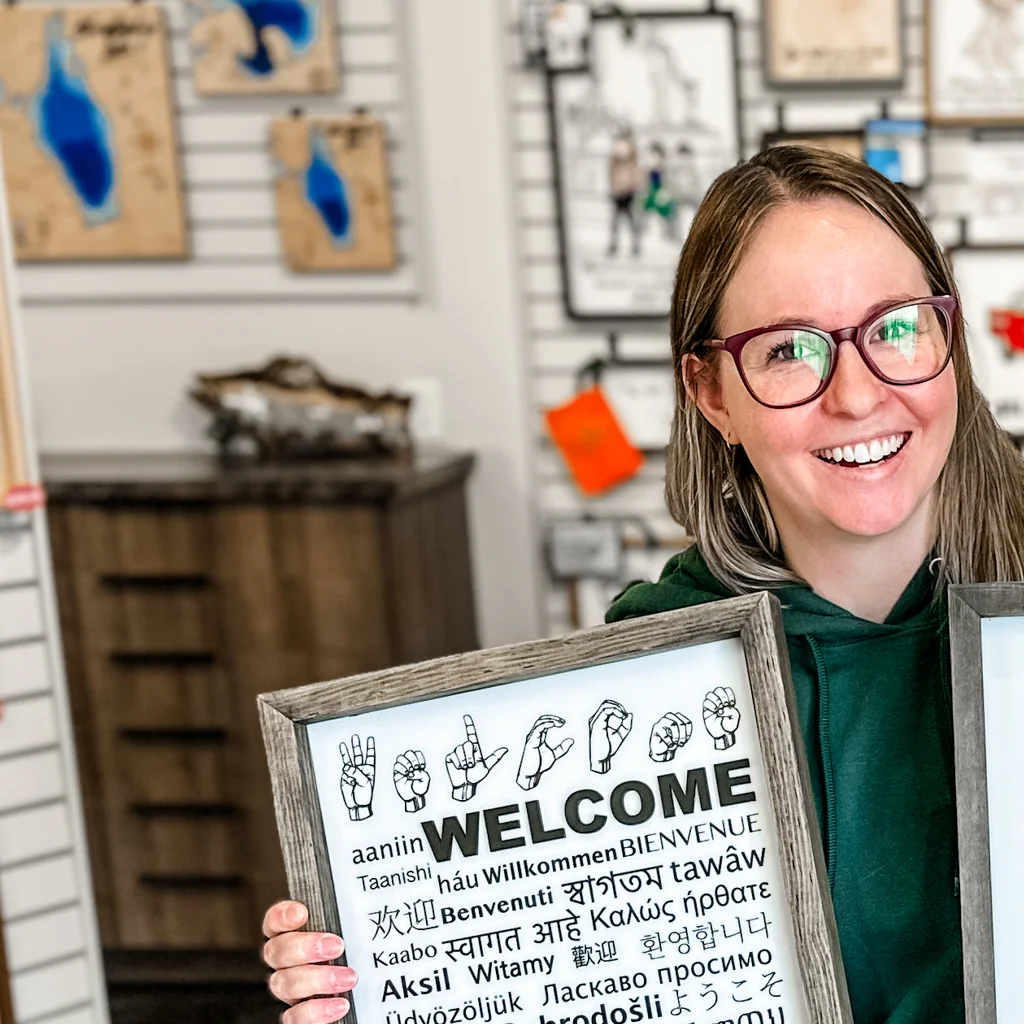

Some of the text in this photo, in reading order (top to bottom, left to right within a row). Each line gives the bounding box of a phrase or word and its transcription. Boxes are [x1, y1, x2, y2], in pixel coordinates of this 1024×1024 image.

[420, 758, 756, 863] WELCOME
[352, 835, 424, 865] aaniin
[620, 813, 762, 858] BIENVENUE
[356, 863, 432, 891] Taanishi
[437, 870, 478, 894] háu
[482, 848, 618, 885] Willkommen
[670, 845, 765, 883] tawâw
[368, 899, 439, 941] 欢迎
[441, 886, 553, 925] Benvenuti
[590, 882, 771, 931] Καλώς ήρθατε
[441, 909, 581, 962] स्वागत आहे
[571, 940, 618, 969] 歡迎
[640, 912, 772, 960] 환영합니다
[373, 943, 437, 968] Kaabo
[468, 955, 554, 984] Witamy
[382, 967, 451, 1002] Aksil
[542, 949, 772, 1006] Ласкаво просимо
[670, 971, 783, 1016] ようこそ
